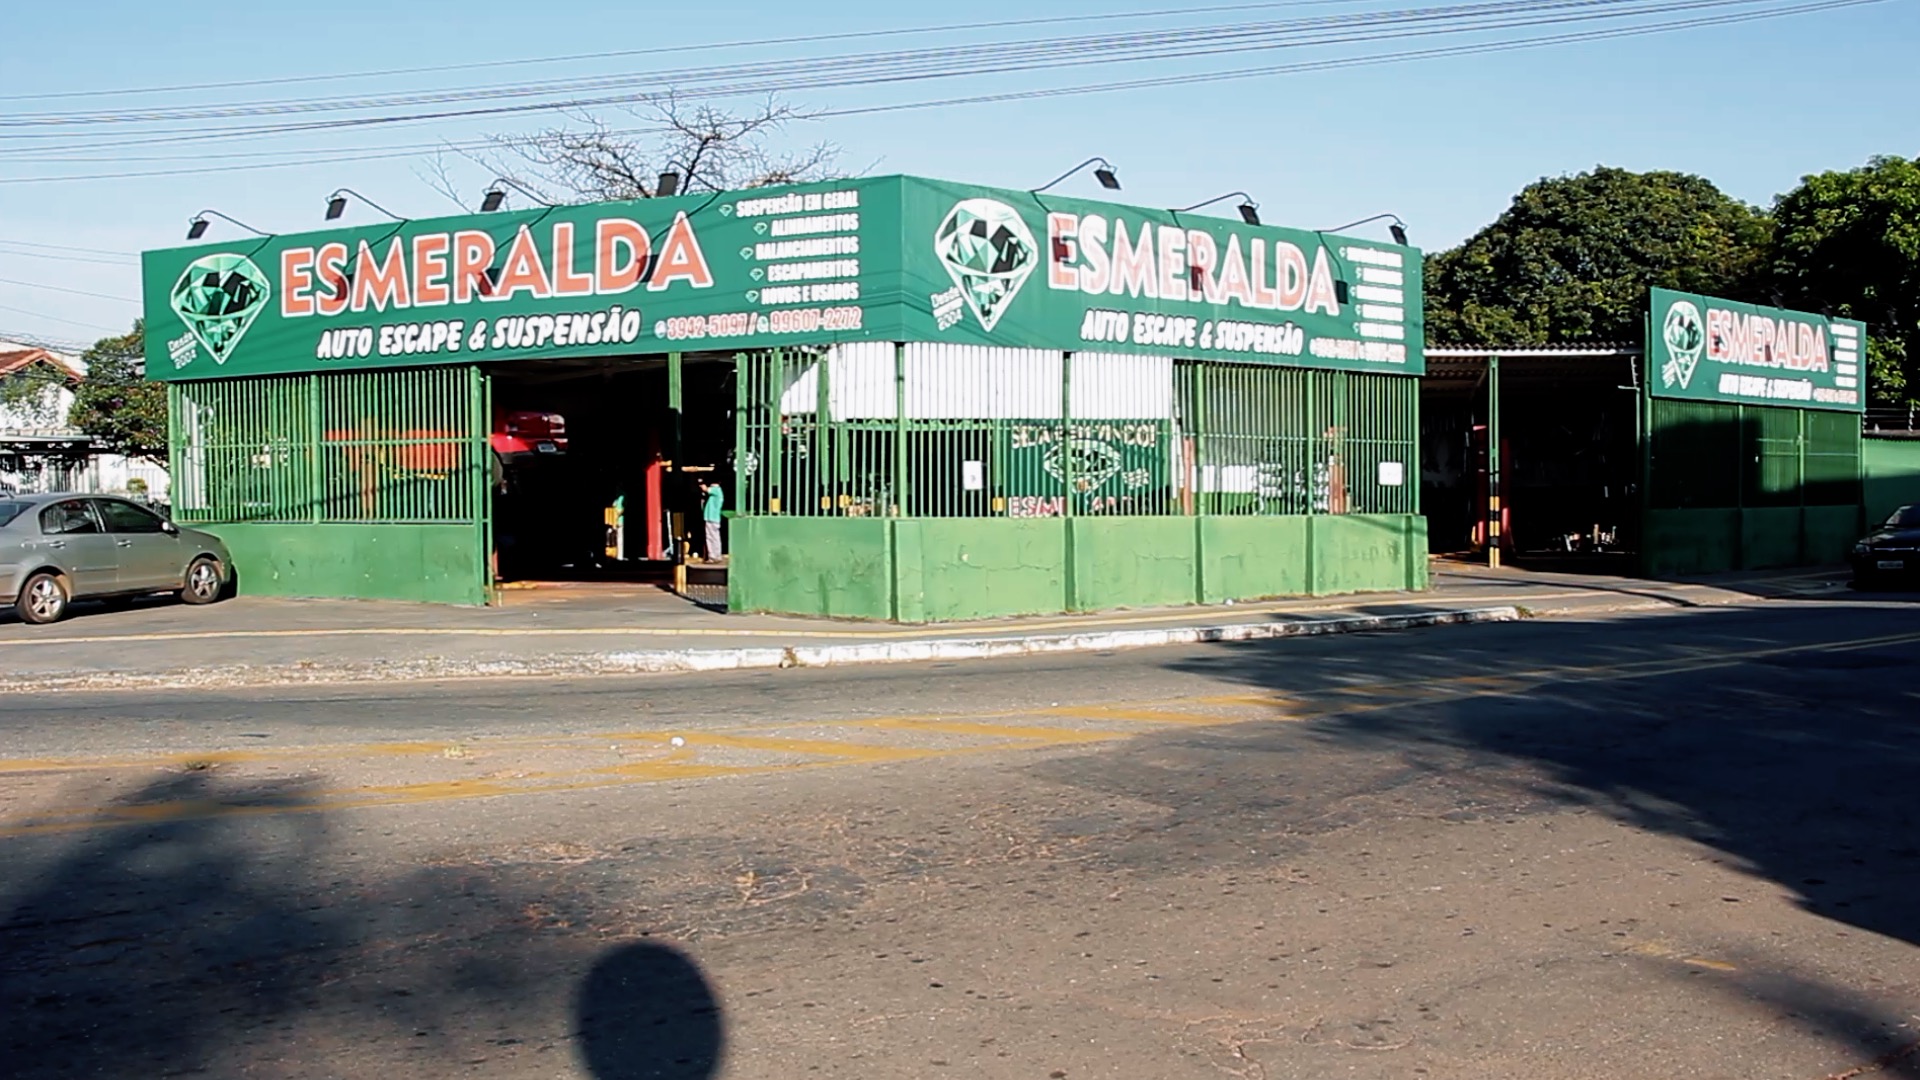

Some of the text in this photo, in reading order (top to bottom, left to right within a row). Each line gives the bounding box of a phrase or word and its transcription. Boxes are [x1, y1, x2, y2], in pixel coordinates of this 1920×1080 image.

[736, 191, 859, 217] SUSPENSÃO EM GERAL
[281, 210, 714, 318] ESMERALDA
[768, 259, 859, 282] ESCAPAMENTOS
[1047, 212, 1340, 316] ESMERALDA
[761, 282, 859, 305] NOVOS E USADOS
[317, 306, 641, 359] AUTO ESCAPE & SUSPENSÃO
[770, 306, 862, 334] 99607-2272
[1080, 308, 1129, 343] AUTO
[1133, 314, 1197, 348] ESCAPE
[1199, 322, 1212, 349] &
[1214, 320, 1303, 356] SUSPENSÃO
[1707, 308, 1828, 373] ESMERALDA
